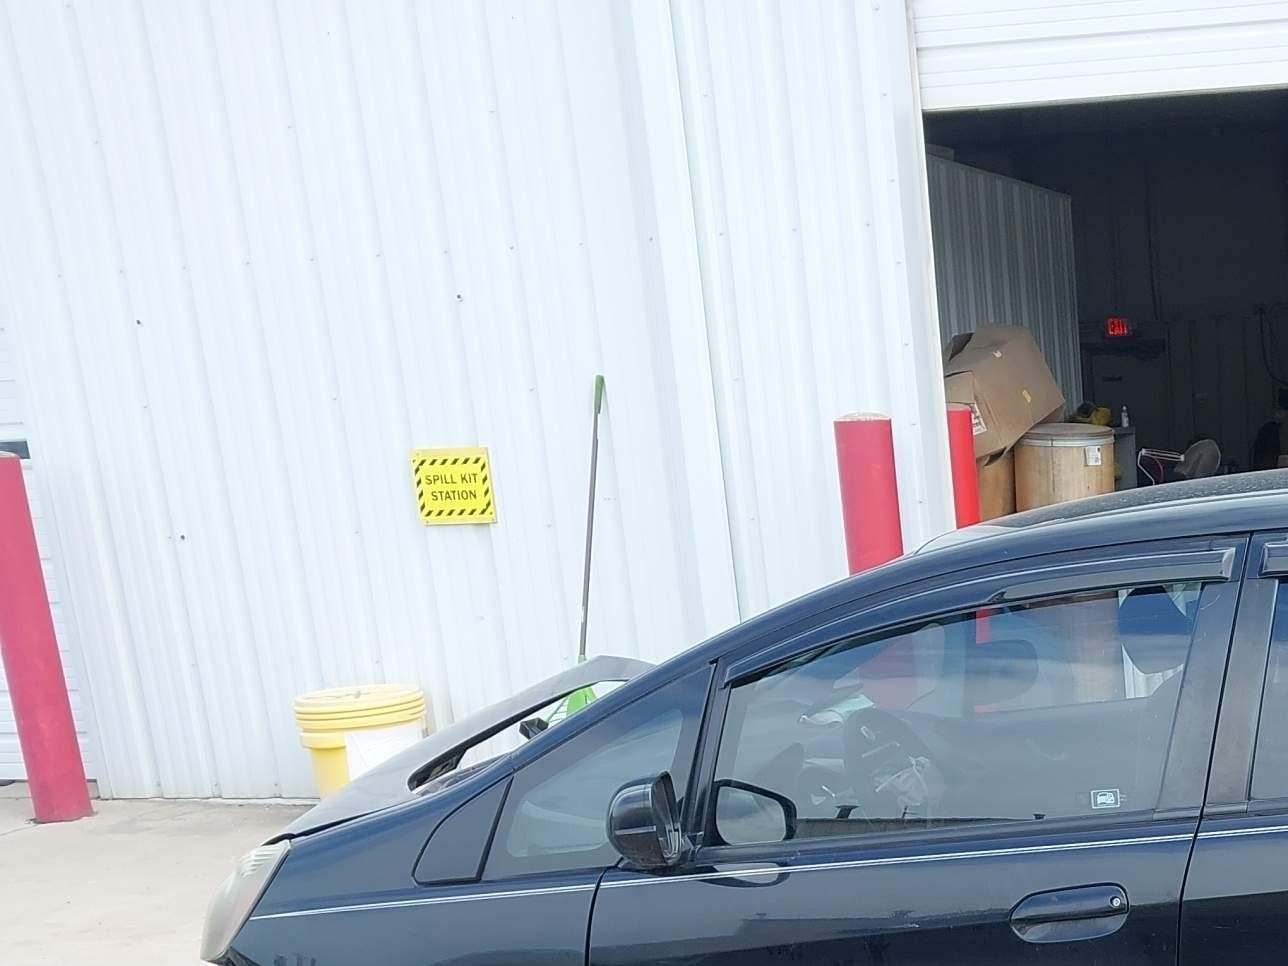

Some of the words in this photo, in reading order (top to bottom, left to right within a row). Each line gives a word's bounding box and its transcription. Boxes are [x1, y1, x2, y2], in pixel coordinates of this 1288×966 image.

[424, 474, 457, 485] SPILL
[460, 473, 478, 484] KIT
[431, 490, 477, 501] STATION
